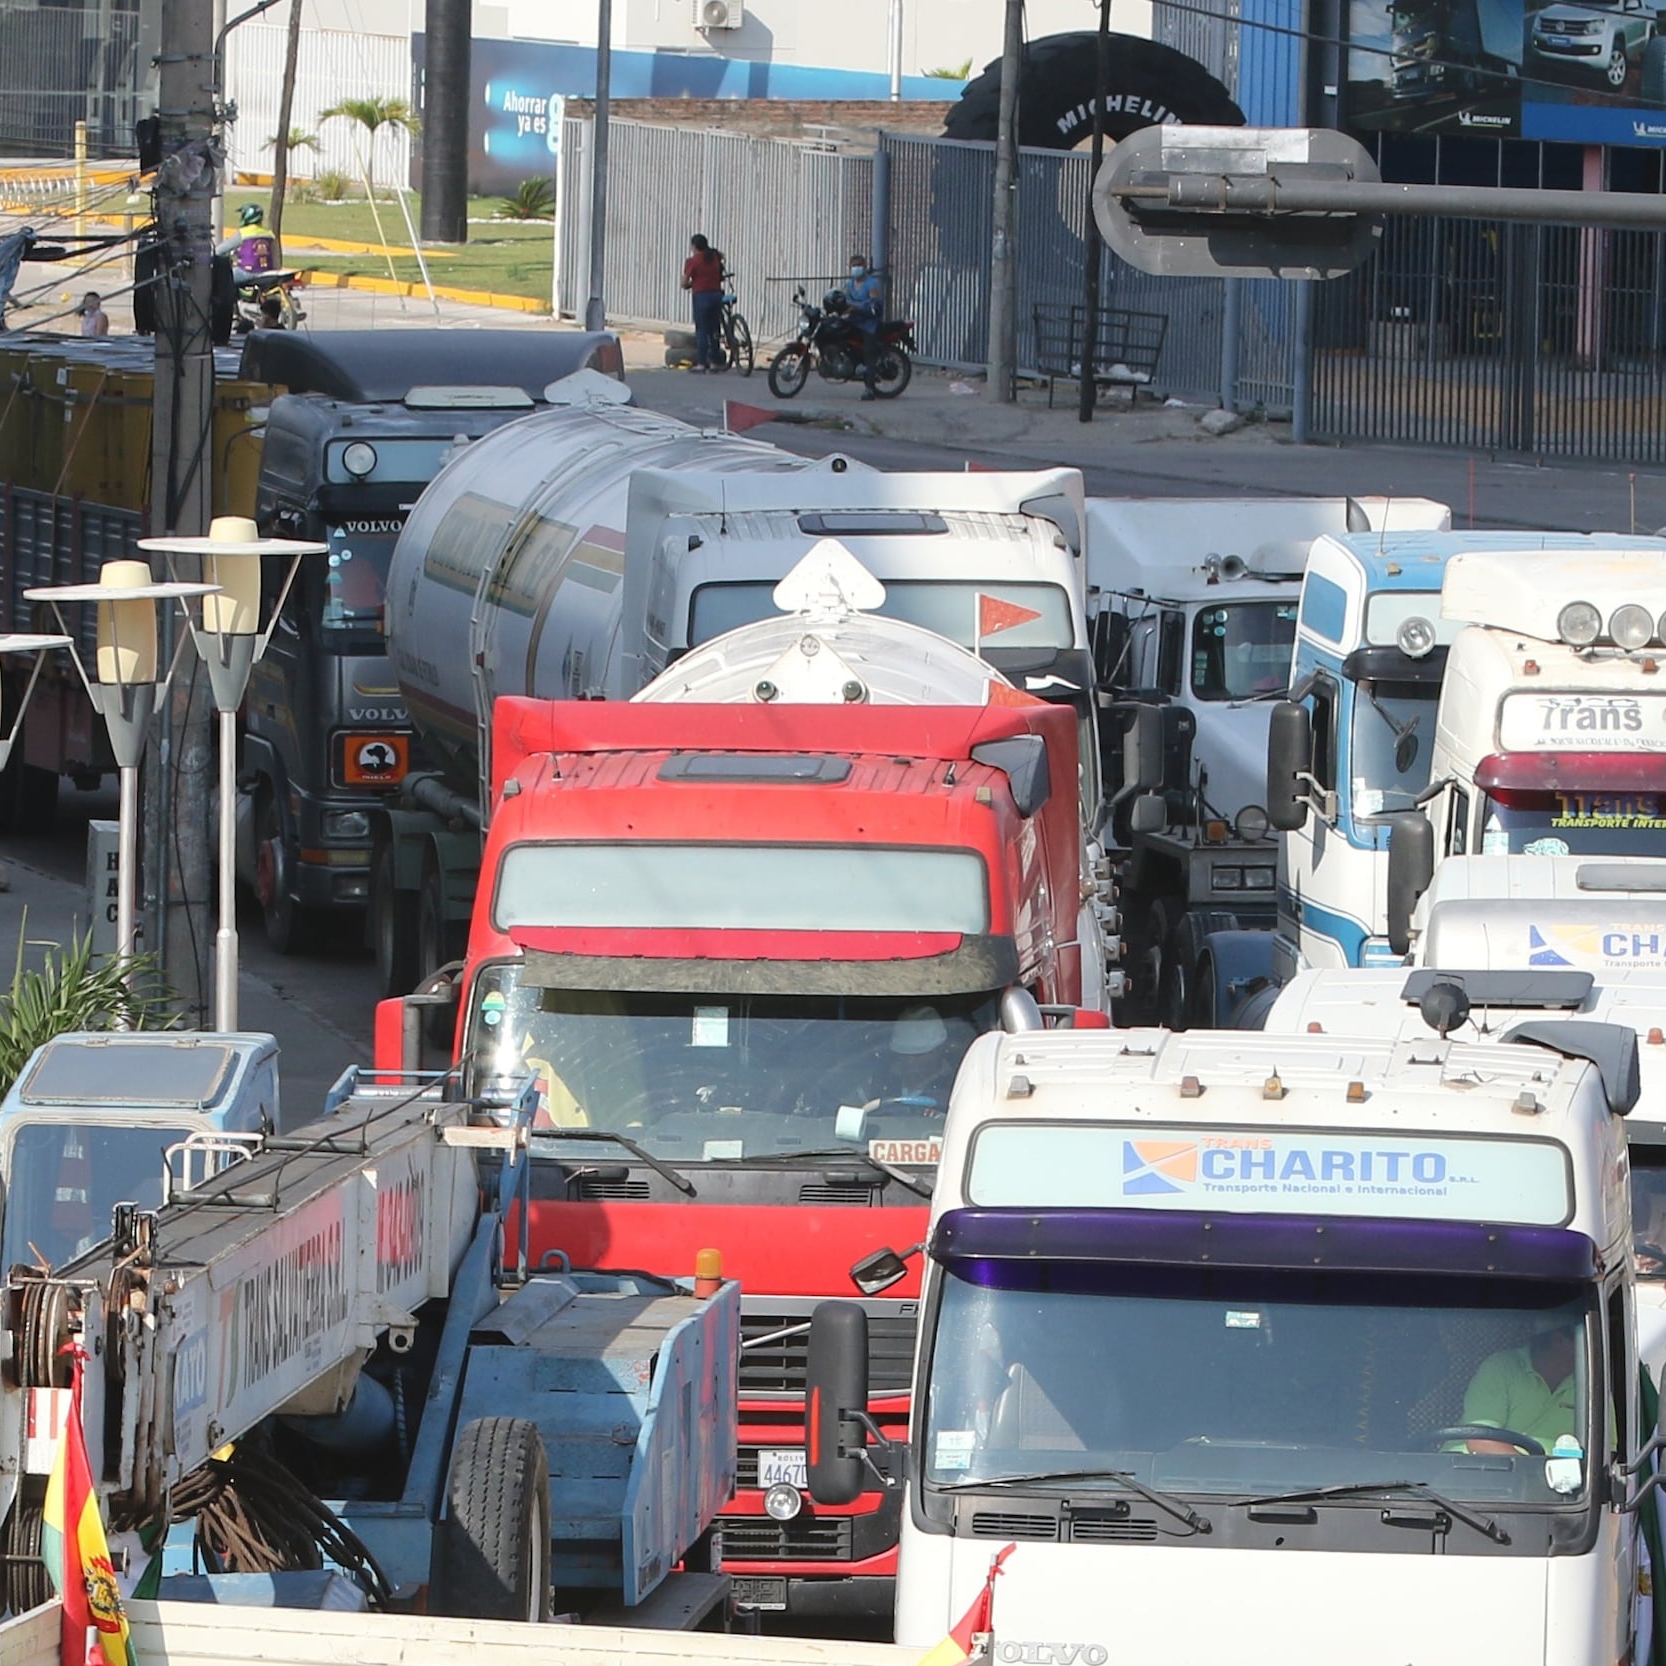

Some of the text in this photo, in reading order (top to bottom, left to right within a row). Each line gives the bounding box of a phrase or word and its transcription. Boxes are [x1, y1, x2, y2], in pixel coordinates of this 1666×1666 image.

[503, 90, 546, 114] Ahorrar
[518, 114, 546, 137] ya es
[346, 520, 402, 533] VOLVO
[1551, 817, 1630, 829] TRANSPORTE
[1604, 959, 1661, 969] Transporte
[1202, 1136, 1273, 1150] TRANS
[872, 1142, 941, 1163] CARGA
[1201, 1149, 1446, 1184] CHARITO
[1203, 1182, 1448, 1196] Transporte Nacional e Internacional
[994, 1641, 1108, 1666] OLVO
